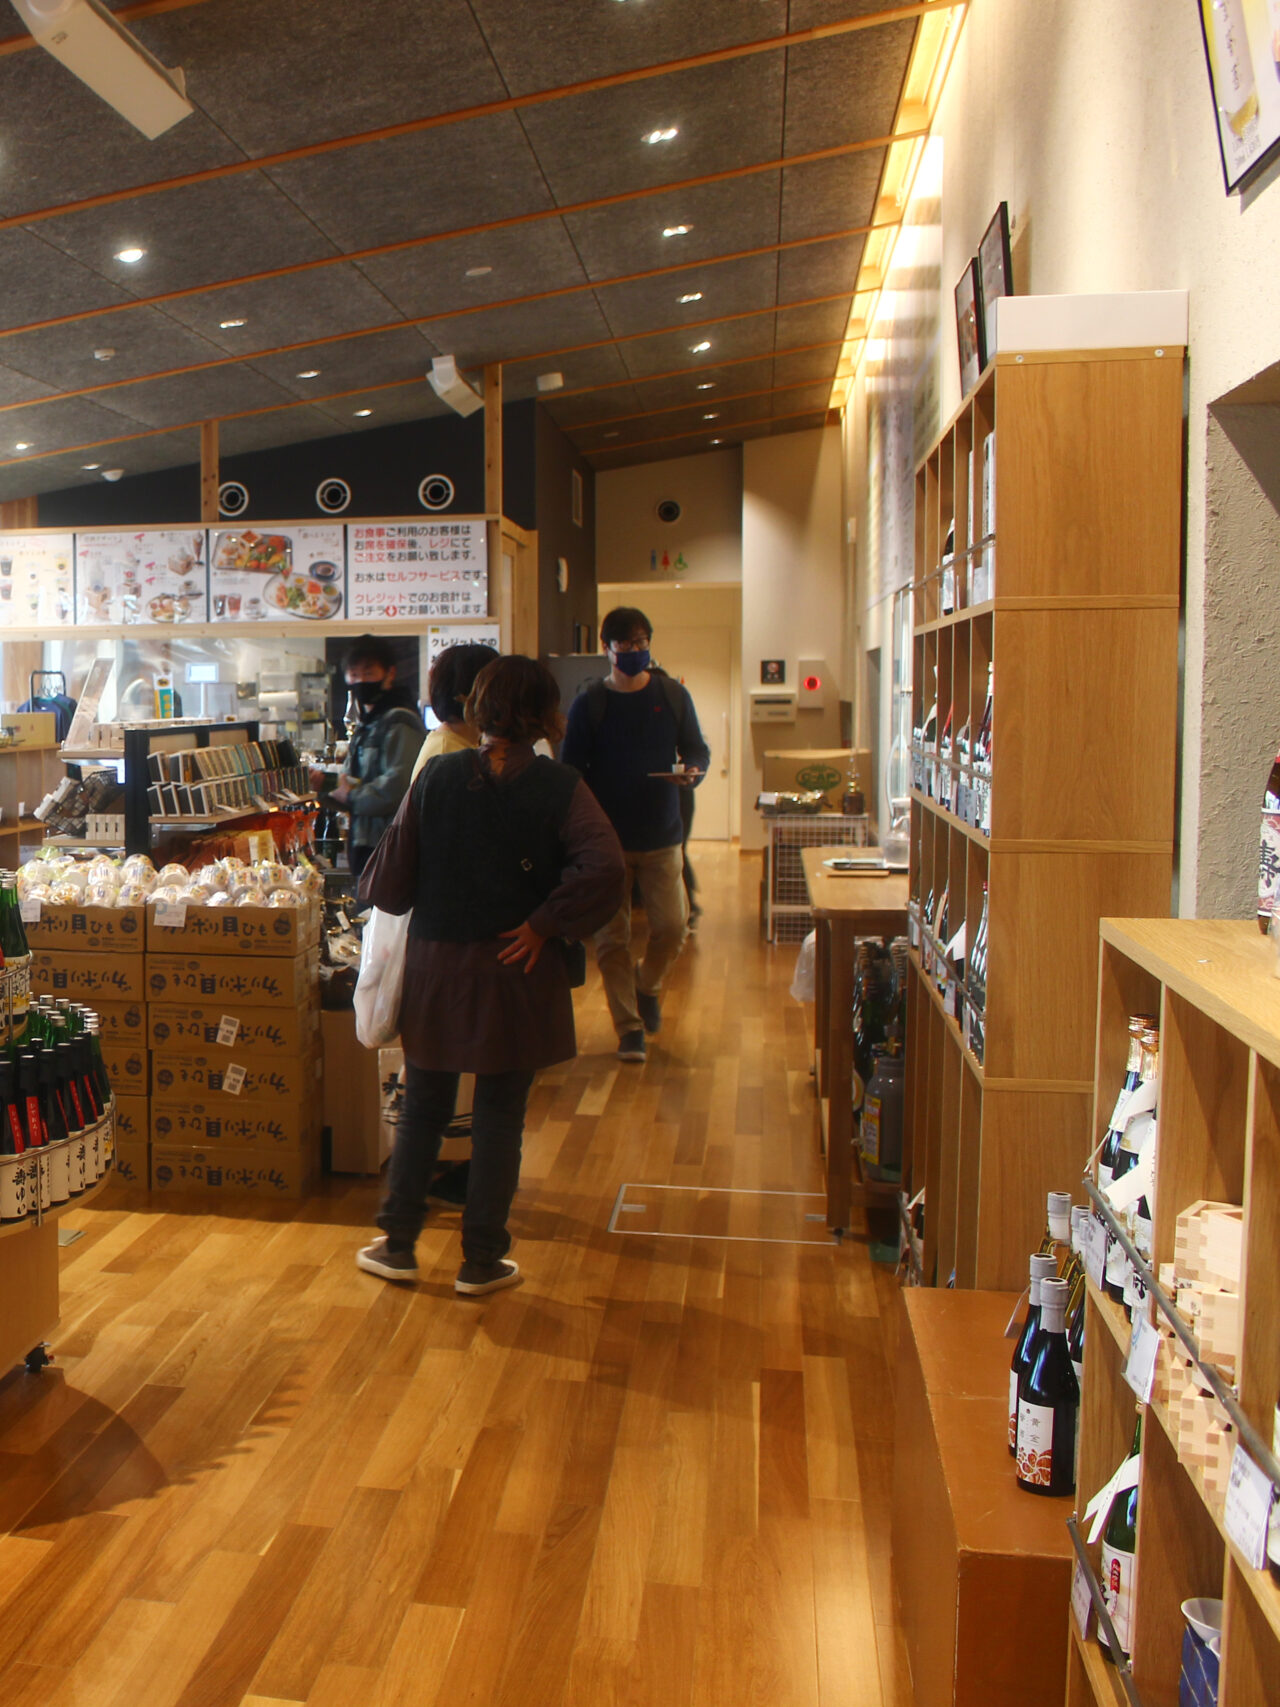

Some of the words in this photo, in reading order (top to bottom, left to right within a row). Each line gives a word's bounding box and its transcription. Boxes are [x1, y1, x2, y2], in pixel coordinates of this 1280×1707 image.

[354, 525, 472, 539] お食事ご利用のお客様は
[354, 551, 477, 563] ご注文をお願い致します。
[354, 592, 472, 604] クレジットでのお会計は
